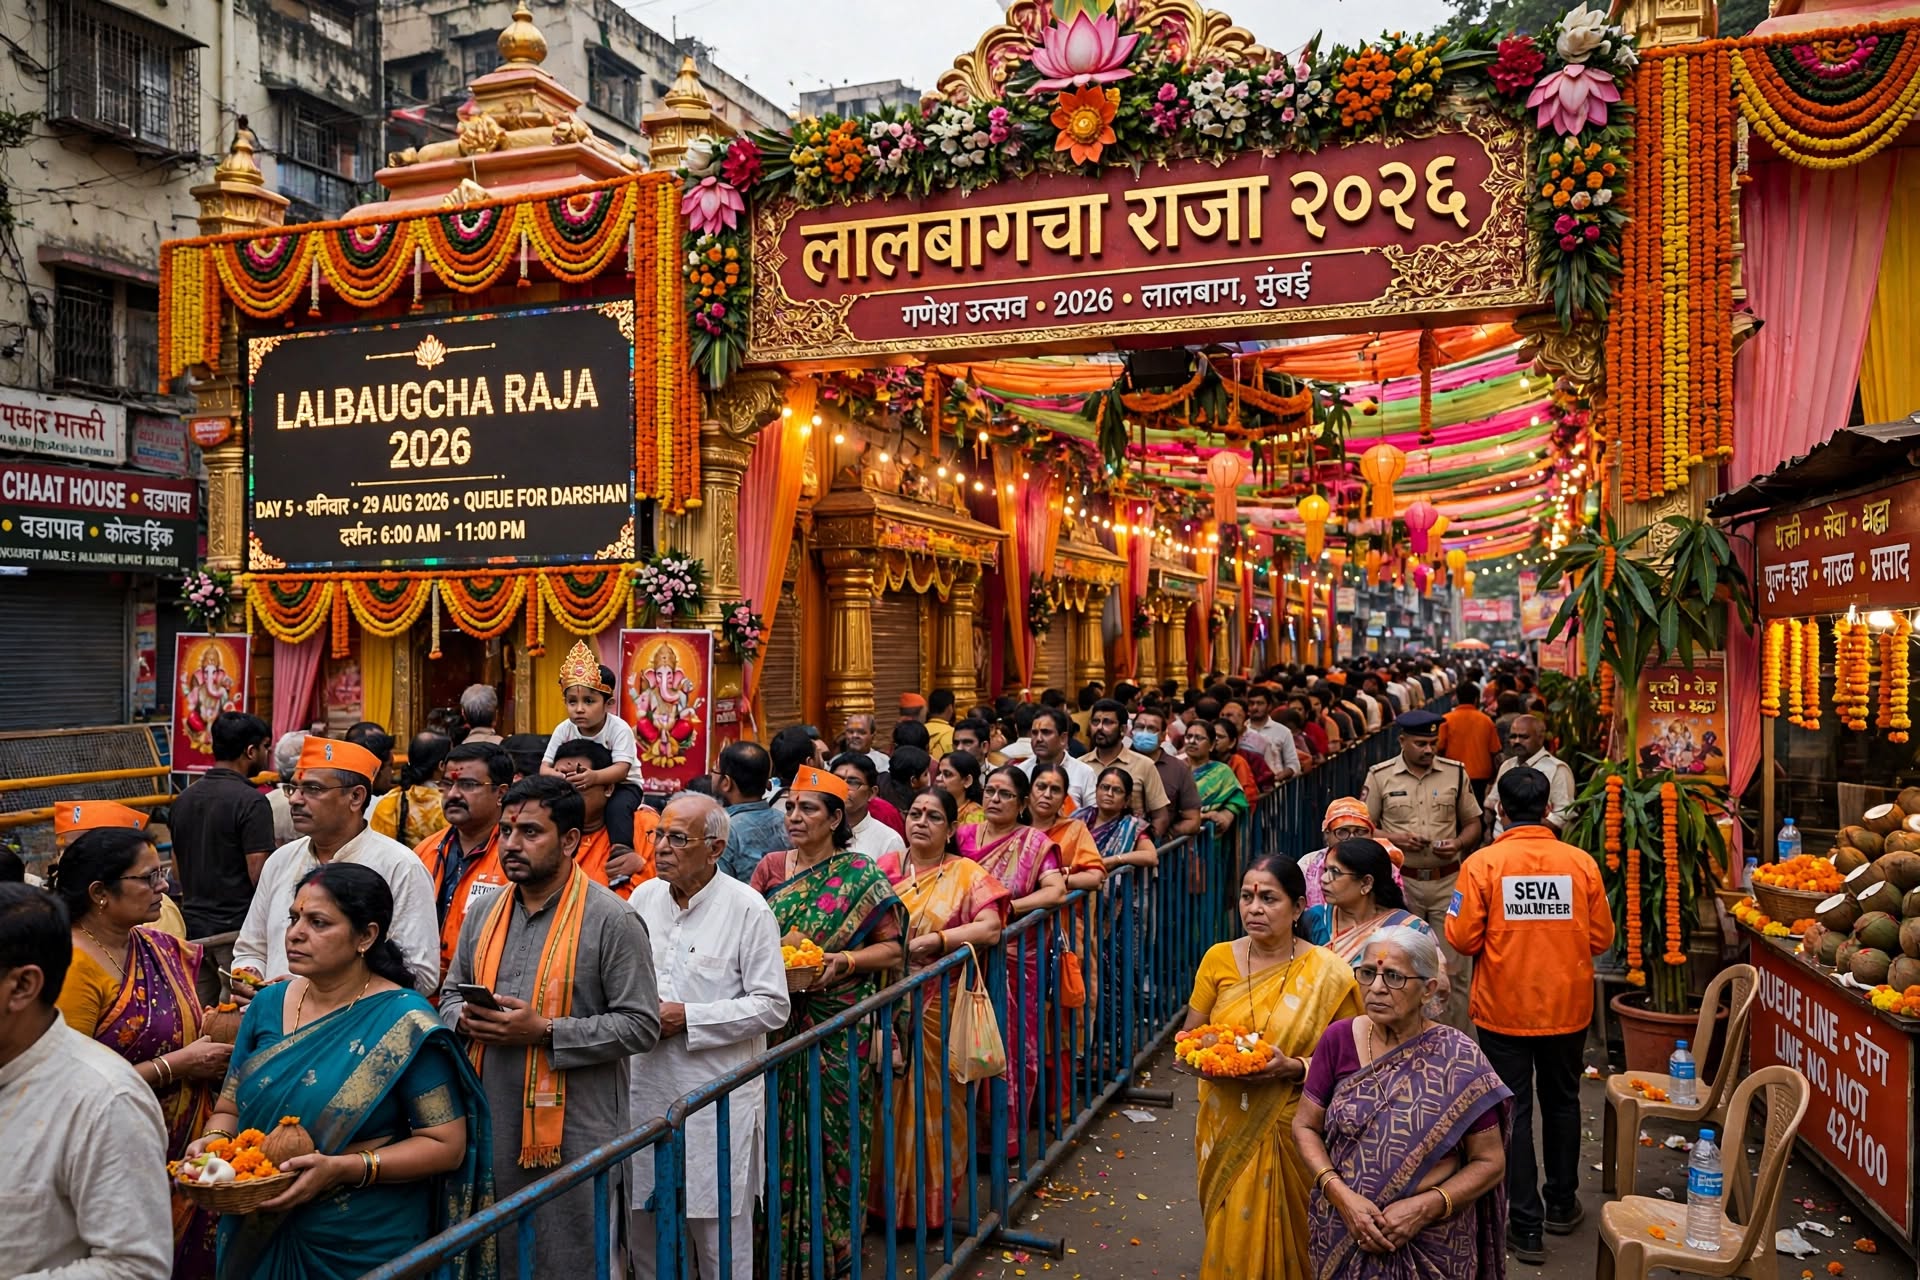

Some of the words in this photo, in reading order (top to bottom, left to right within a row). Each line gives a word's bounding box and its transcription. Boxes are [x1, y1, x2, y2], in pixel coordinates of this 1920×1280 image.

[800, 193, 1109, 284] लालबागचा
[1124, 175, 1269, 252] राजा
[1290, 155, 1470, 239] २०२६
[901, 295, 958, 328] गणेश
[965, 295, 1028, 323] उत्सव
[1053, 288, 1113, 317] 2026
[1141, 277, 1247, 309] लालबाग,
[1254, 261, 1312, 308] मुंबई
[277, 376, 494, 430] LALBAUGCHA
[504, 368, 599, 414] RAJA
[389, 427, 471, 469] 2026
[2, 471, 64, 503] CHAAT
[69, 477, 126, 509] HOUSE
[143, 488, 191, 514] वडापाव
[255, 500, 282, 519] DAY
[285, 499, 294, 517] 5
[305, 493, 350, 518] शनिवार
[362, 496, 379, 514] 29
[383, 494, 412, 513] AUG
[415, 492, 449, 511] 2026
[464, 489, 514, 510] QUEUE
[517, 488, 548, 506] FOR
[550, 483, 627, 506] DARSHAN
[19, 515, 85, 542] वडापाव
[339, 522, 377, 547] दर्शन:
[380, 525, 412, 544] 6:00
[415, 524, 440, 543] AM
[455, 522, 497, 541] 11:00
[500, 520, 525, 539] PM
[1870, 543, 1910, 582] प्रसाद
[1515, 881, 1560, 900] SEVA
[1758, 966, 1802, 1029] QUEUE
[1805, 996, 1839, 1055] LINE
[1855, 1026, 1889, 1087] रांग
[1775, 1024, 1803, 1073] LINE
[1806, 1048, 1831, 1097] NO.
[1836, 1067, 1869, 1123] NOT
[1826, 1107, 1888, 1187] 42/100
